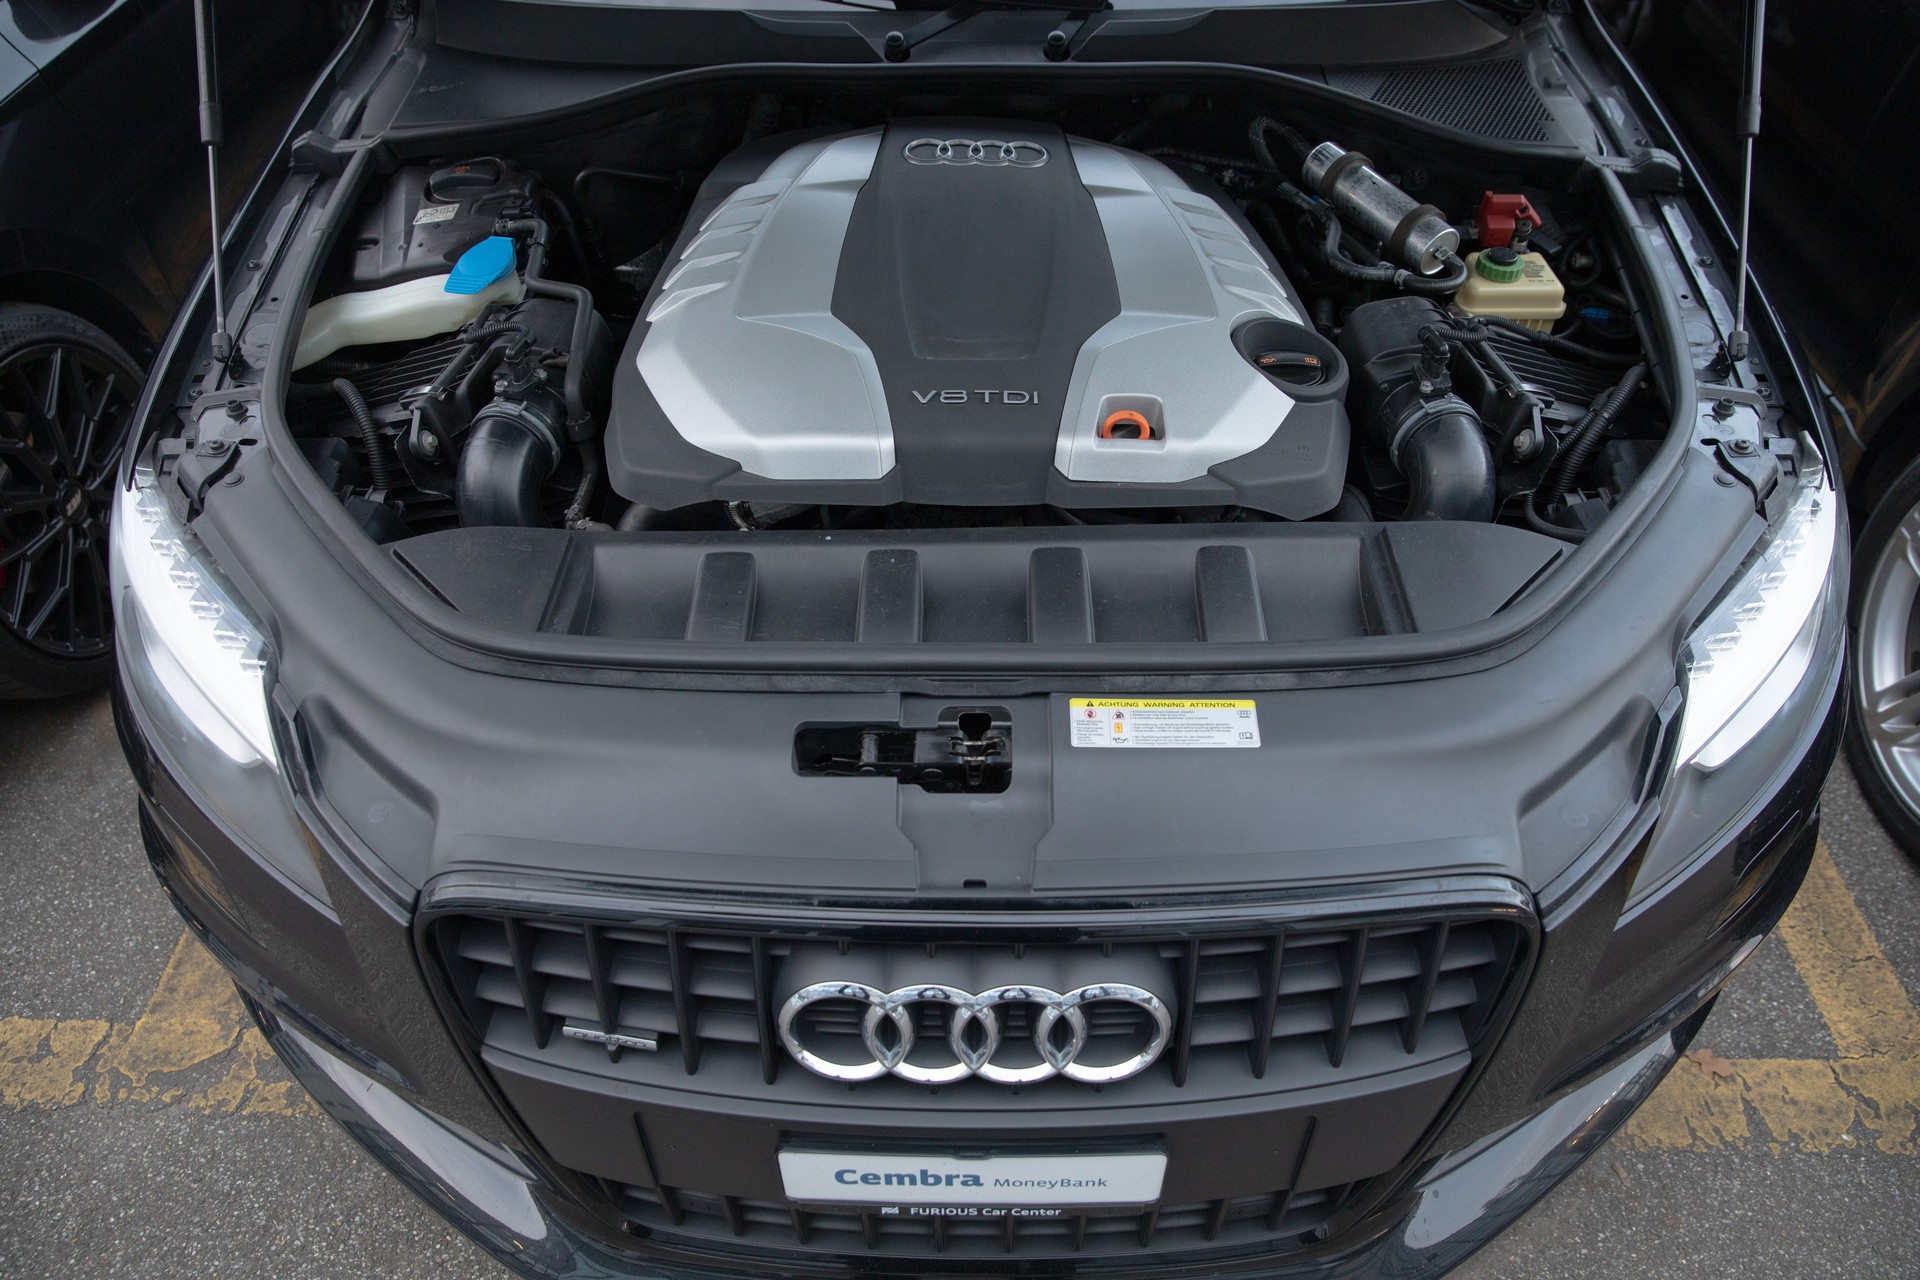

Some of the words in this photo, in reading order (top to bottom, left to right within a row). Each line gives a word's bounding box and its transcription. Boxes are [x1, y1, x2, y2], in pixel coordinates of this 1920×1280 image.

[912, 389, 968, 404] V8
[974, 389, 1039, 404] TDI
[573, 1032, 646, 1047] quattro
[834, 1169, 984, 1187] Cembra
[994, 1177, 1108, 1189] MoneyBank
[910, 1207, 978, 1216] FURIOUS
[982, 1207, 1007, 1216] Car
[1011, 1207, 1062, 1216] Center
